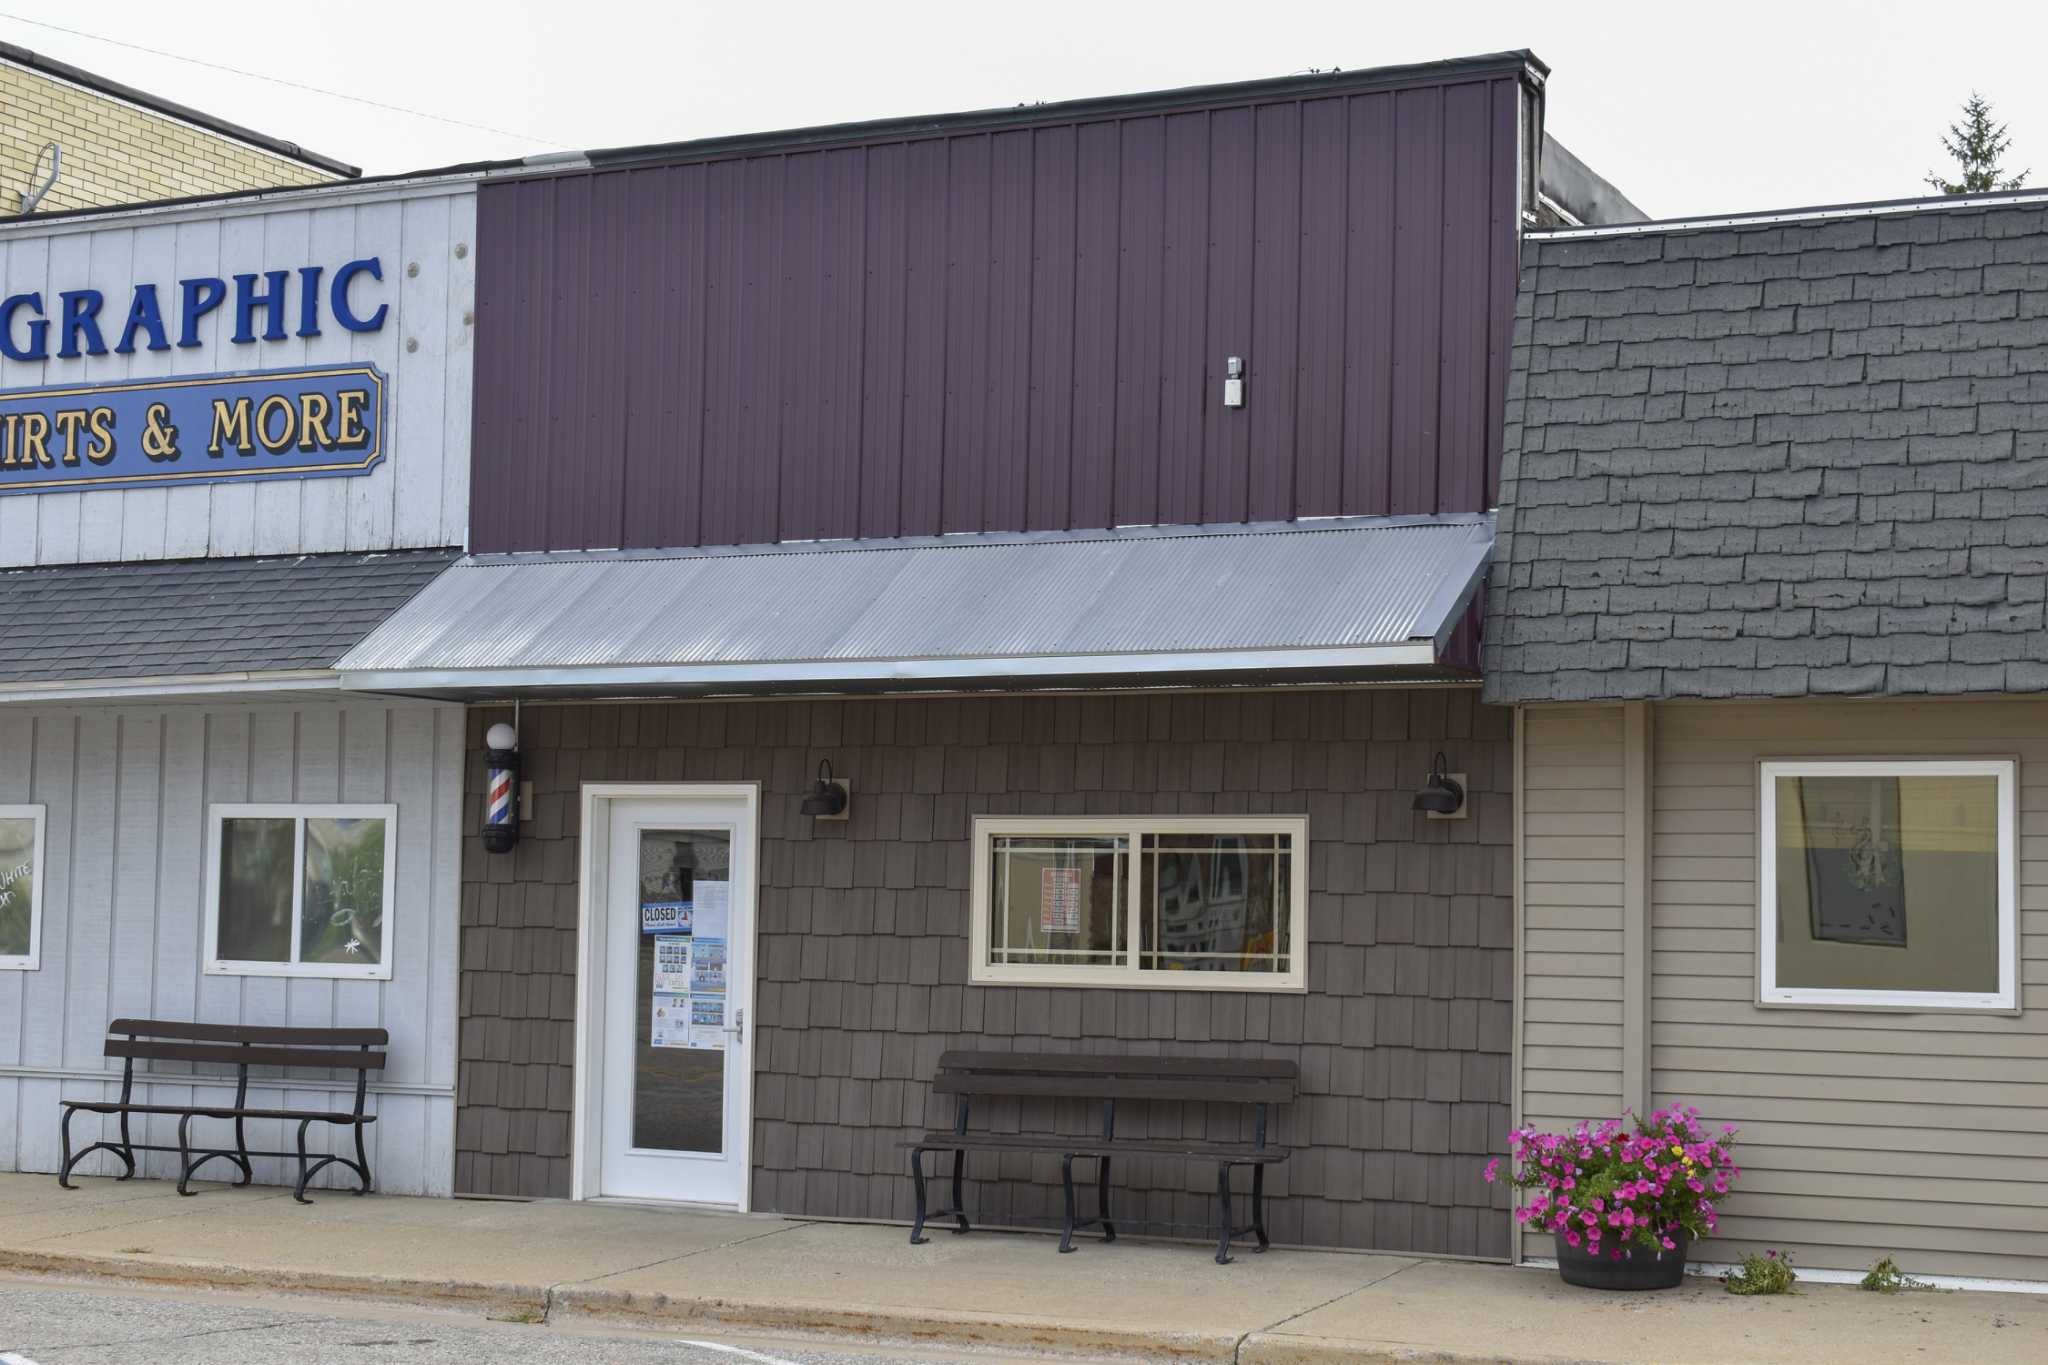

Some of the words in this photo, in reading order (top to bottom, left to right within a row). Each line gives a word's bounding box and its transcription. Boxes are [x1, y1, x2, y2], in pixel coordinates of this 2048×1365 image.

[0, 257, 389, 362] GRAPHIC
[0, 406, 117, 471] IRTS
[141, 402, 181, 462] &
[208, 389, 369, 458] MORE
[644, 907, 676, 921] CLOSED
